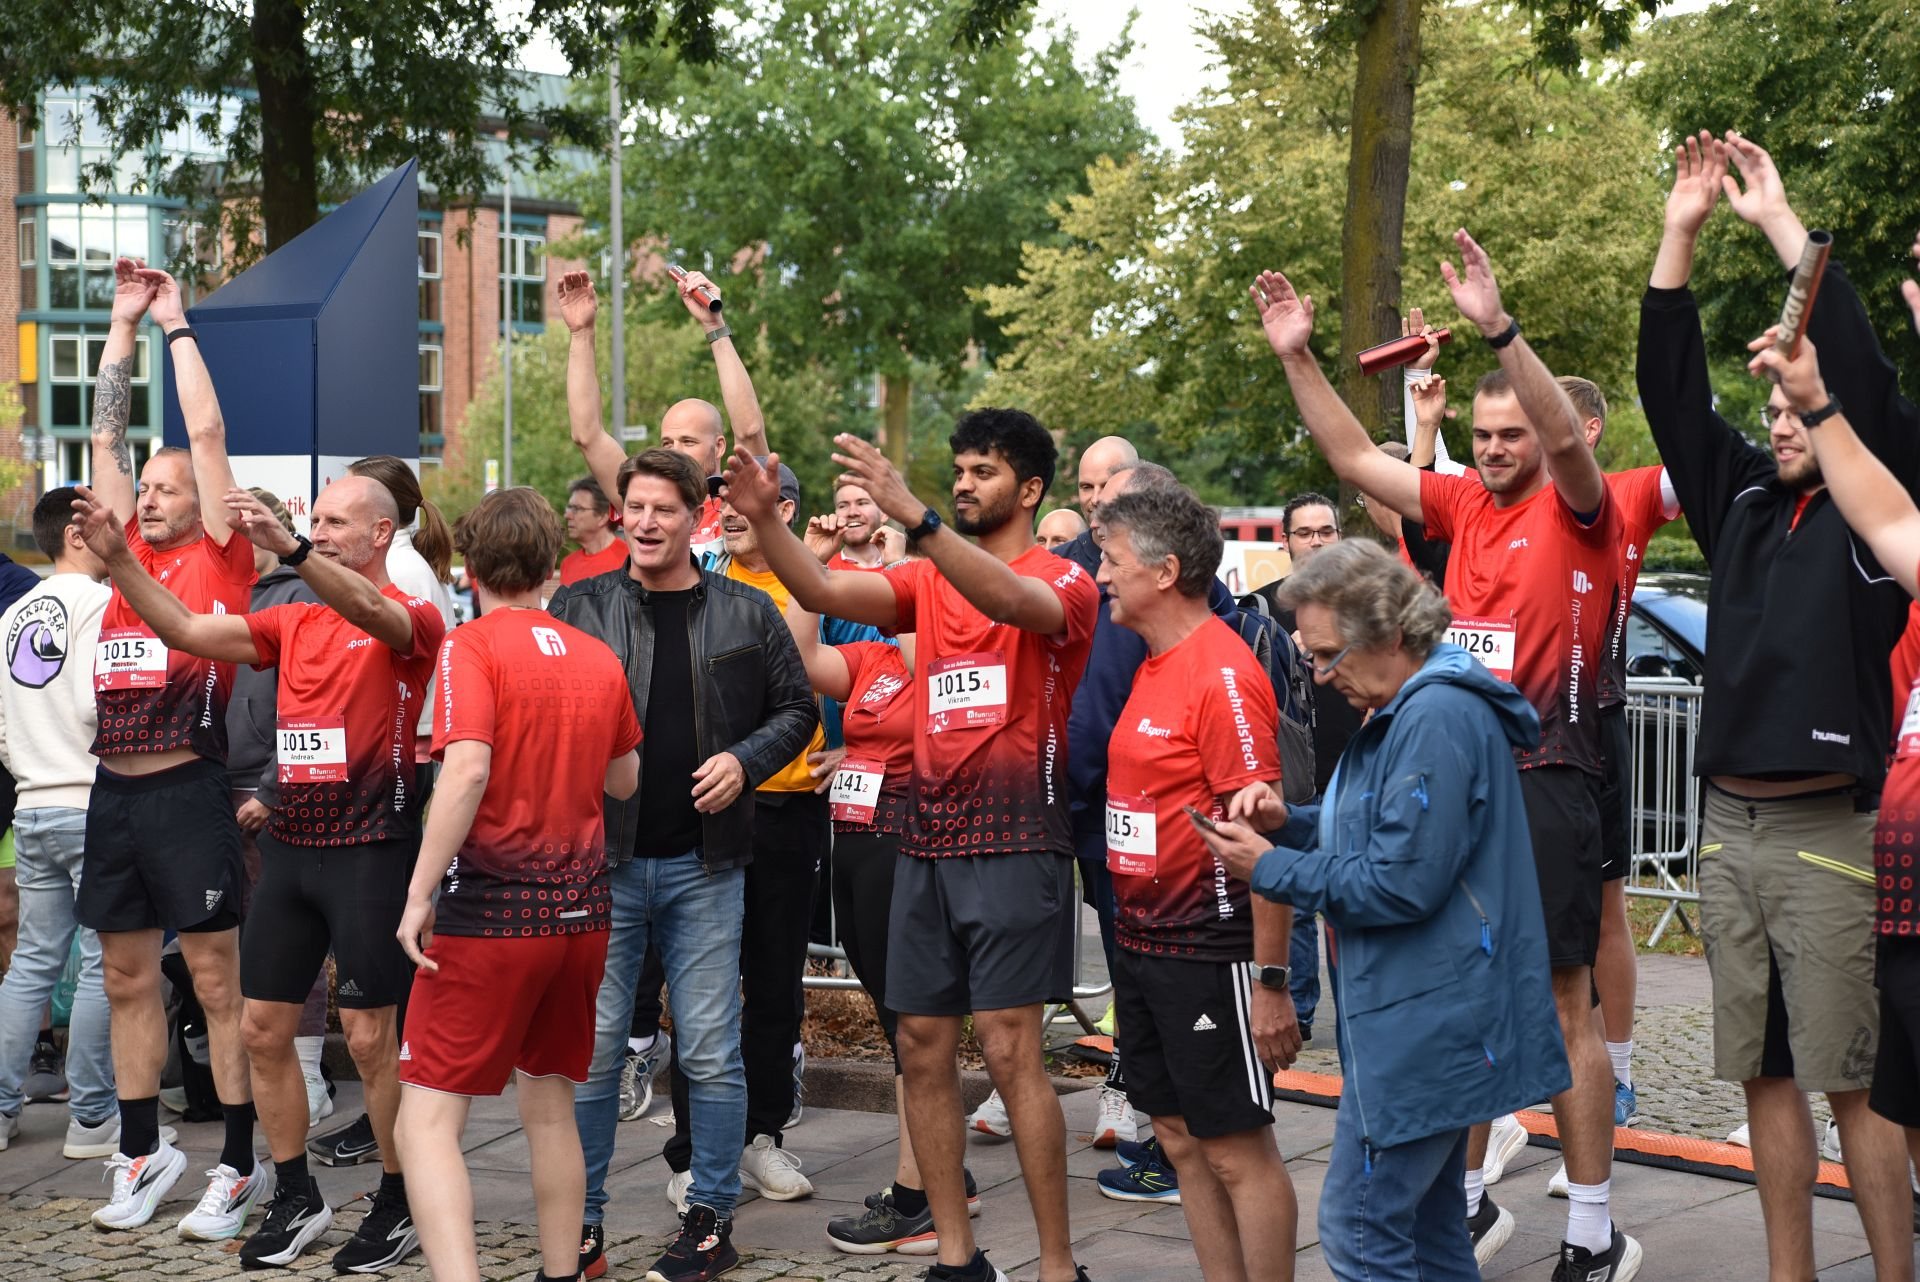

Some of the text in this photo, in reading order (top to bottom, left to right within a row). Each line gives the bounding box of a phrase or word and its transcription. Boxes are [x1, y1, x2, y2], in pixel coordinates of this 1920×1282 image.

[103, 641, 153, 661] 1015 3
[1450, 632, 1502, 654] 1026 4
[440, 639, 455, 733] #mehralsTech
[937, 671, 990, 698] 1015 4
[947, 696, 971, 705] Vikram
[1221, 667, 1259, 771] #mehralsTech
[283, 732, 330, 751] 1015 1
[1146, 725, 1171, 739] sport
[862, 784, 869, 792] 2
[1132, 827, 1140, 838] 2
[1193, 1023, 1217, 1031] adidas
